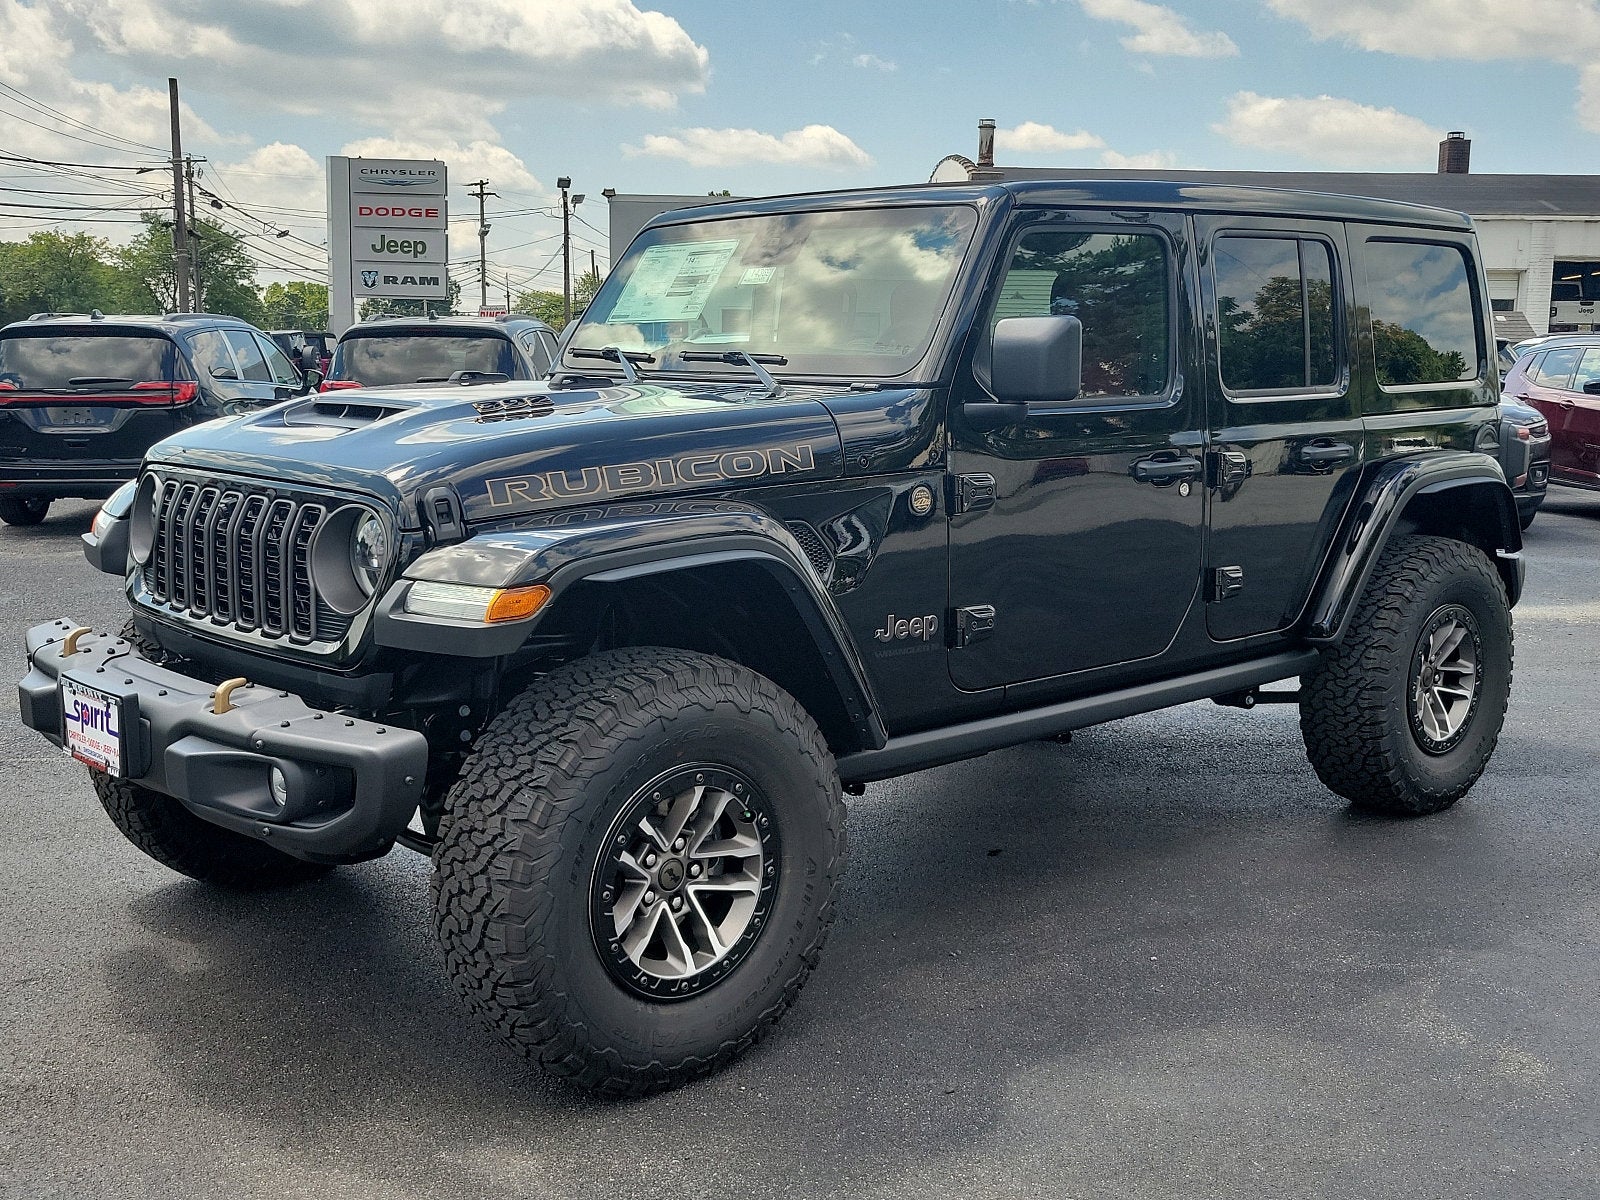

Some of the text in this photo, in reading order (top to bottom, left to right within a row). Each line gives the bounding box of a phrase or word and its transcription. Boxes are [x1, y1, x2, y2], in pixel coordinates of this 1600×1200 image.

[360, 168, 436, 177] CHRYSLER
[358, 206, 439, 218] DODGE
[371, 234, 427, 258] Jeep
[383, 275, 440, 286] RAM
[485, 445, 815, 507] RUBICON
[875, 614, 939, 643] Jeep
